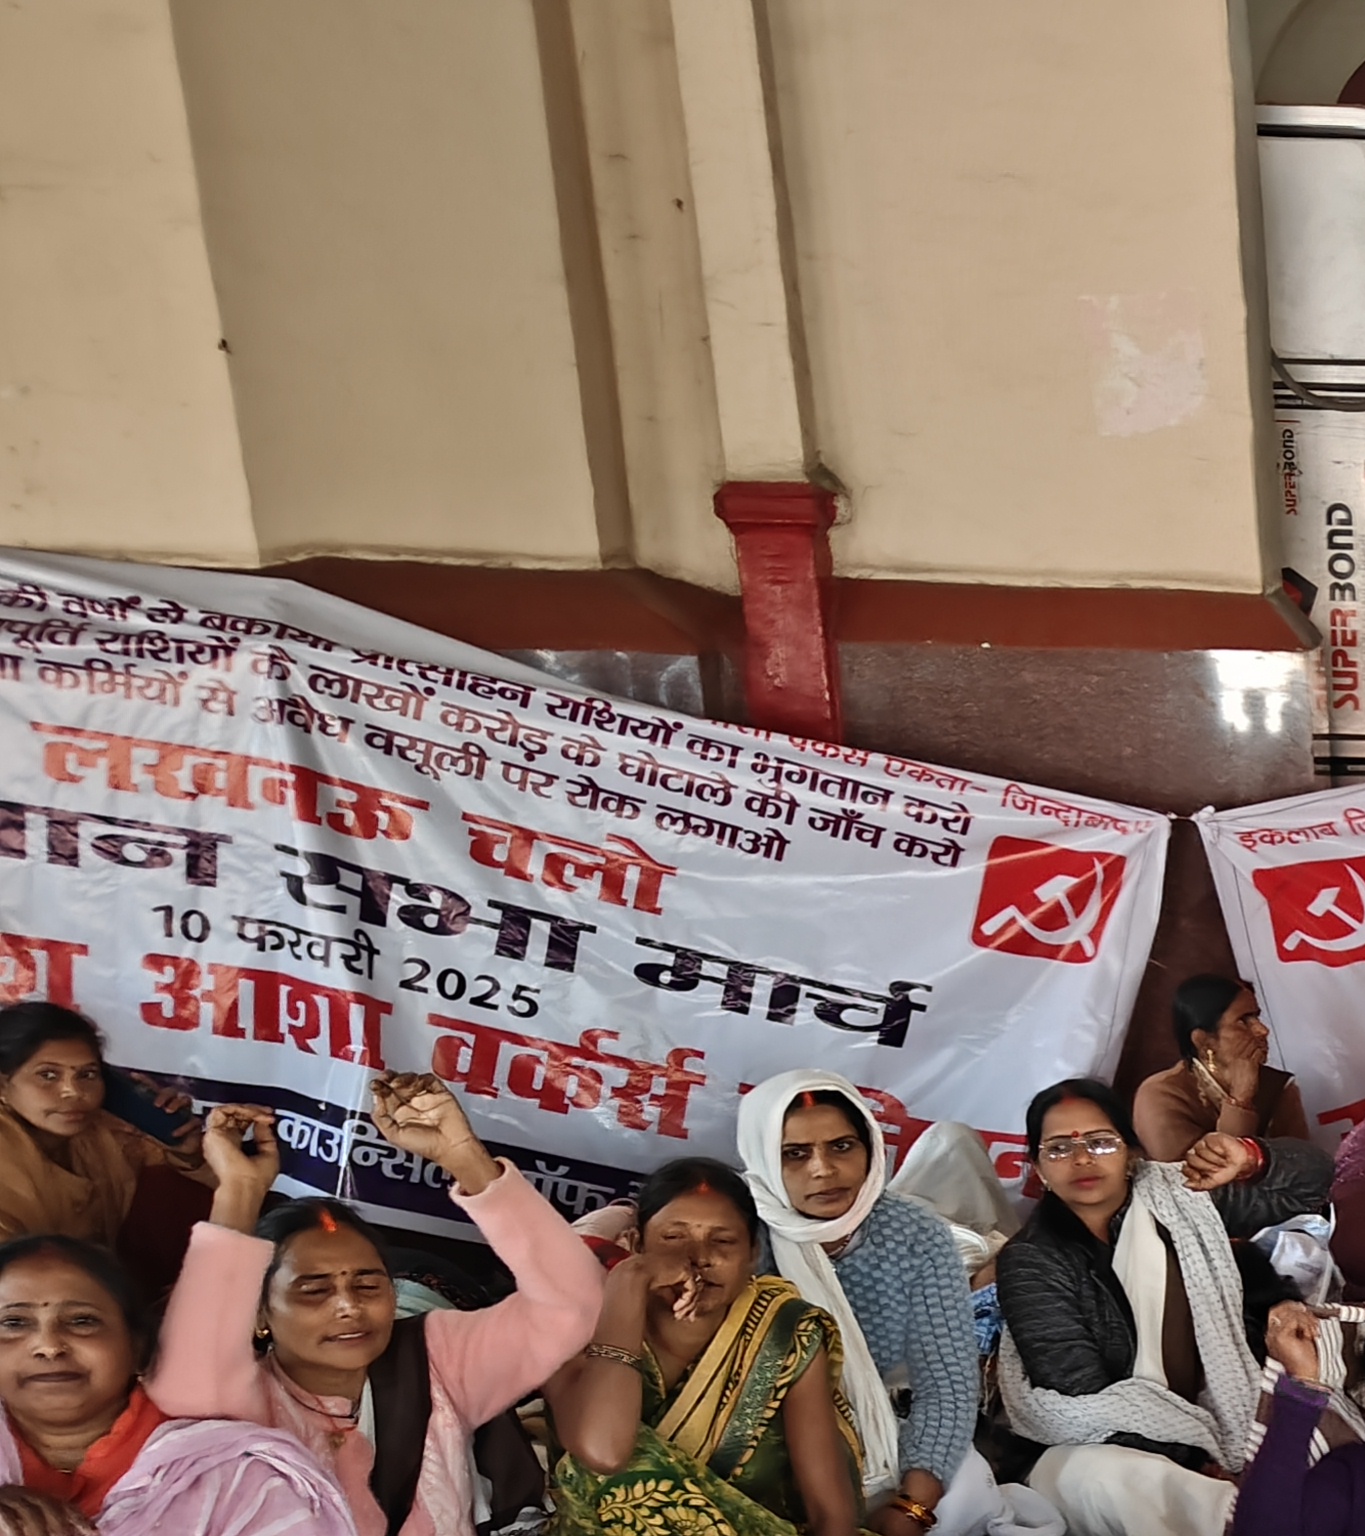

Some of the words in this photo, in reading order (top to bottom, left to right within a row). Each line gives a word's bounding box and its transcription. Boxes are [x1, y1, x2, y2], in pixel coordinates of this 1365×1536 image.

[34, 658, 188, 707] कर्मियों
[198, 678, 237, 716] से
[364, 723, 491, 781] वसूली
[500, 761, 559, 799] पर
[565, 774, 646, 820] रोक
[655, 803, 790, 862] लगाओ
[94, 629, 241, 675] राशियों
[250, 644, 297, 681] के
[307, 664, 436, 721] लाखों
[440, 700, 553, 763] करोड़
[560, 733, 607, 768] के
[617, 750, 739, 807] घोटाले
[744, 786, 801, 825] की
[807, 808, 886, 848] जाँच
[893, 829, 965, 868] करो
[145, 599, 188, 624] से
[545, 690, 684, 750] राशियों
[684, 732, 744, 769] का
[749, 750, 895, 813] भुगतान
[901, 794, 975, 836] करो
[152, 904, 211, 943] 10
[231, 914, 380, 980] फरवरी
[398, 957, 541, 1019] 2025
[274, 843, 597, 973] सभा
[633, 935, 933, 1050] मार्च
[461, 810, 678, 916] चलो
[139, 953, 394, 1072] आशा
[427, 1012, 707, 1140] वर्कर्स
